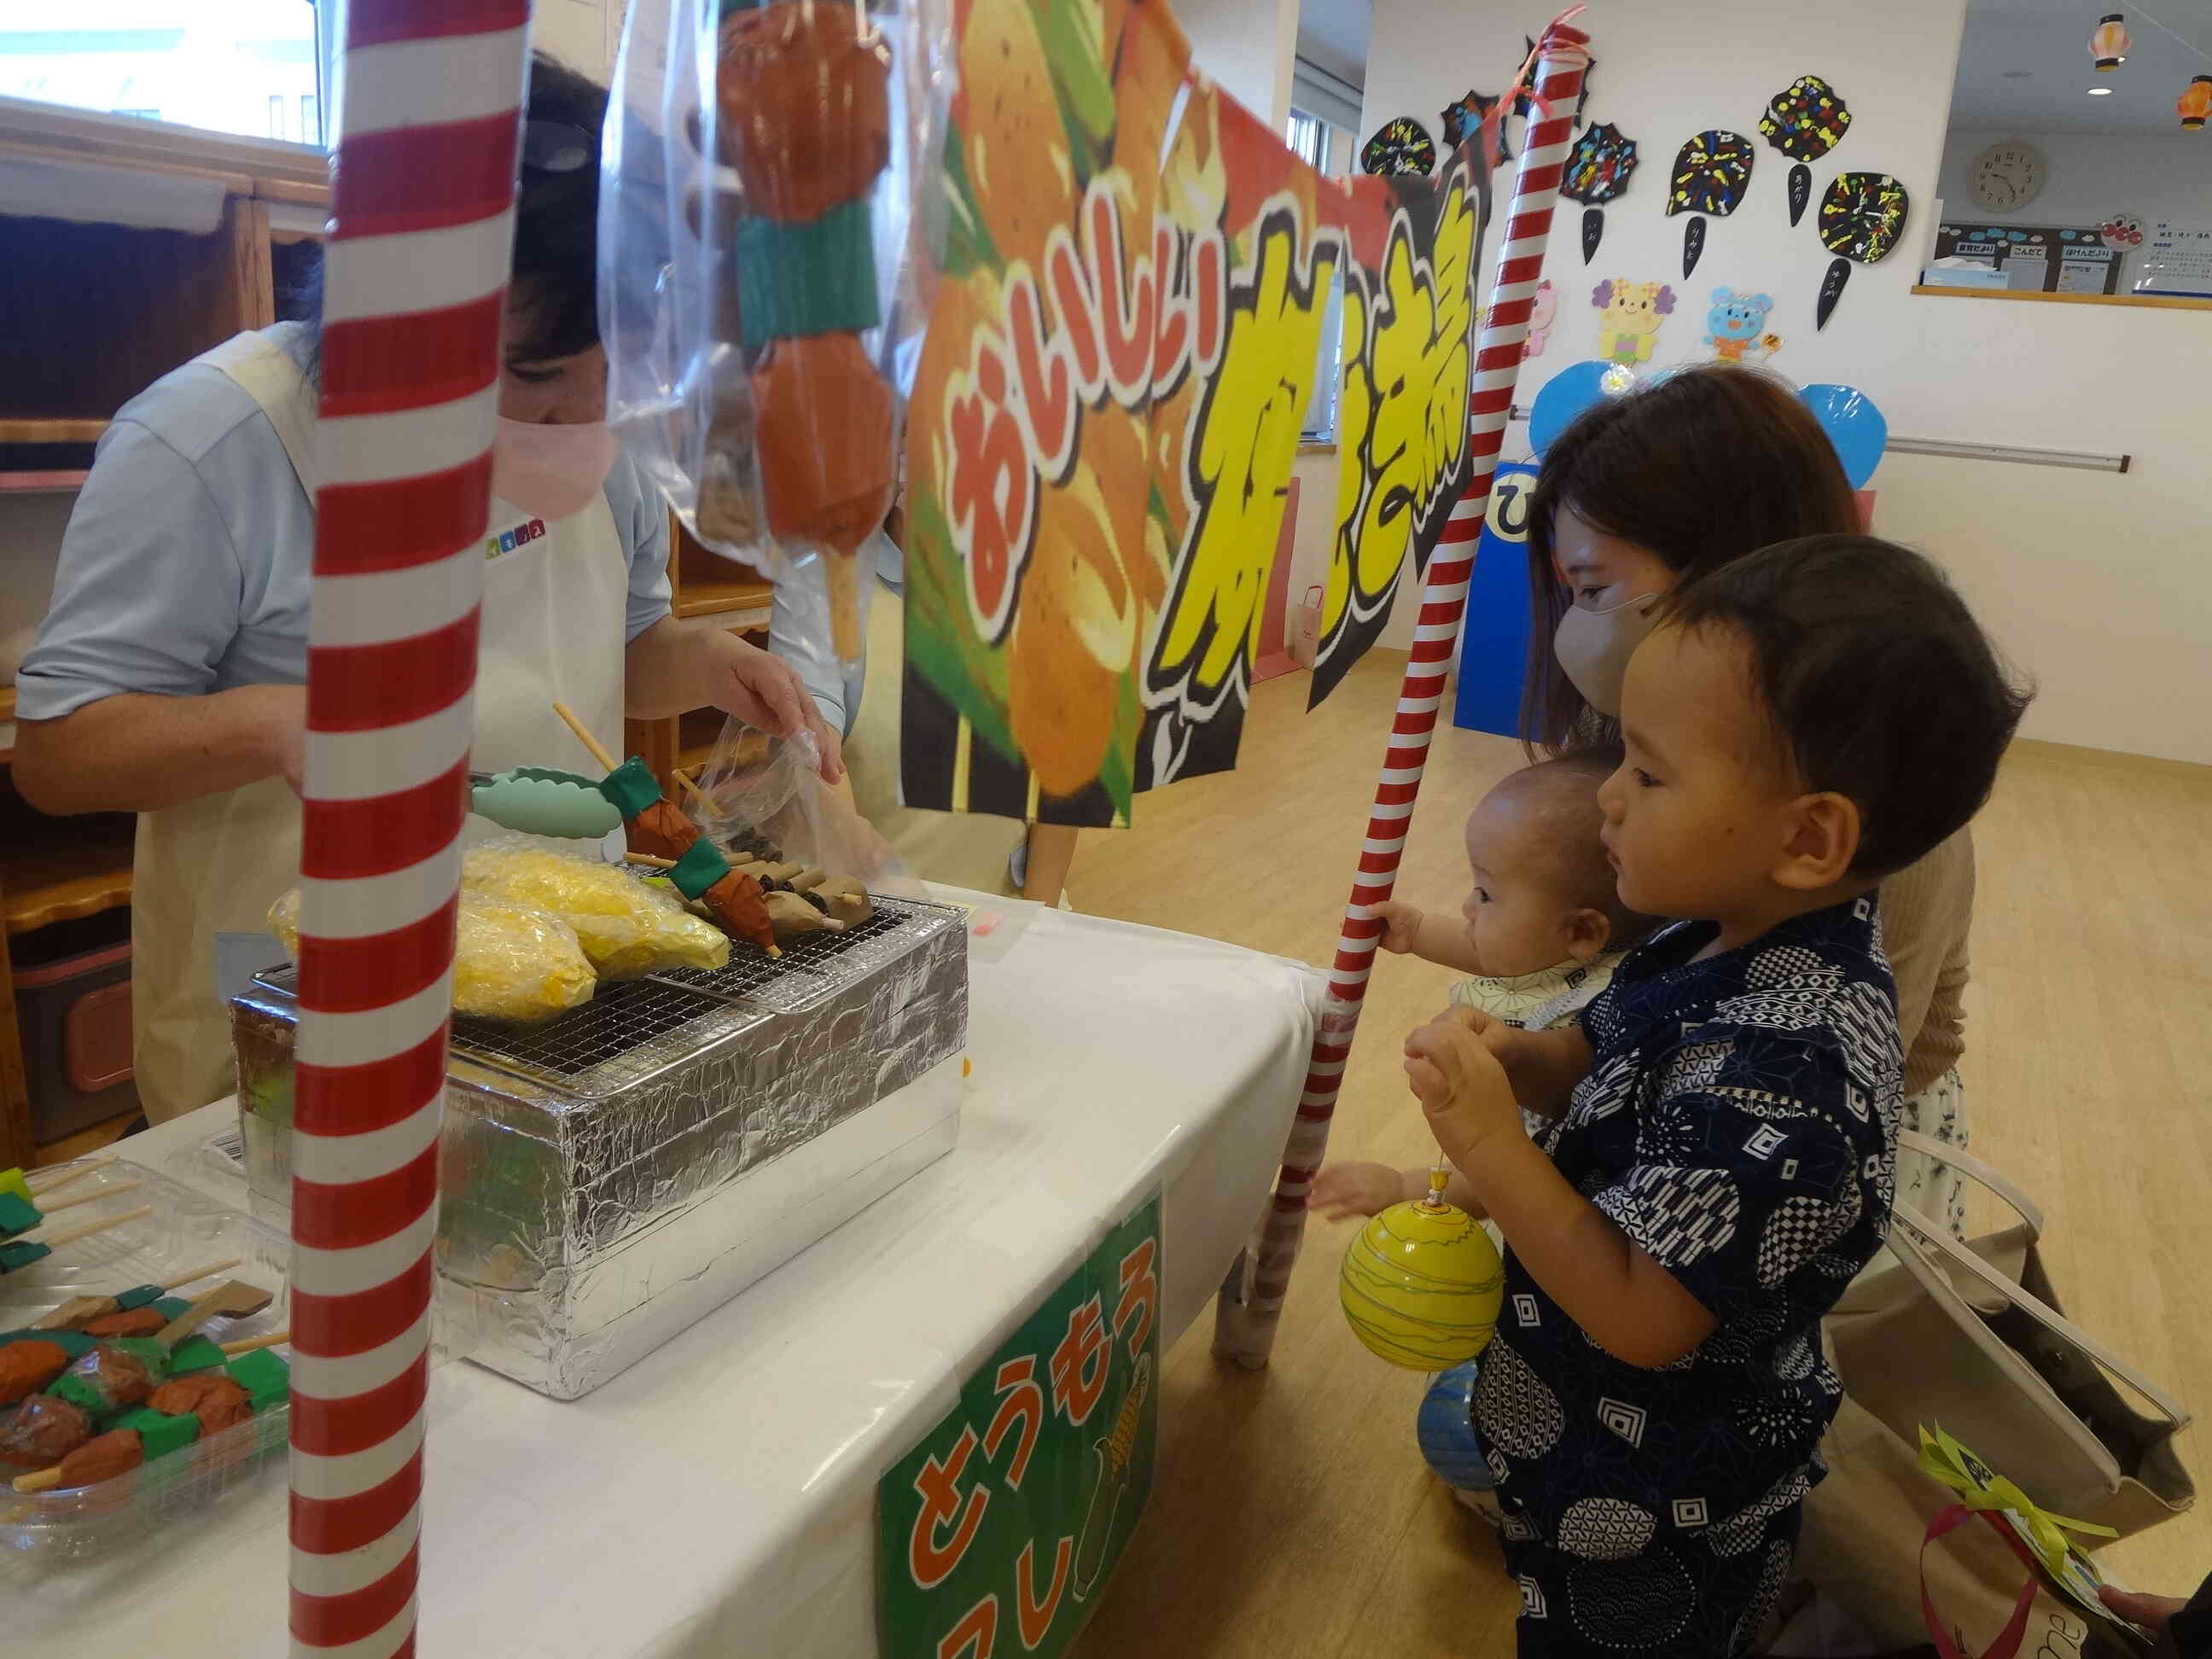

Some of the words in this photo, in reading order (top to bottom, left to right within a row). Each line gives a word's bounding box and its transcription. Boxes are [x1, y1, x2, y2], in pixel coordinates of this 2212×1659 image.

[944, 175, 1226, 640] おいしい
[909, 1236, 1157, 1590] とうもろ
